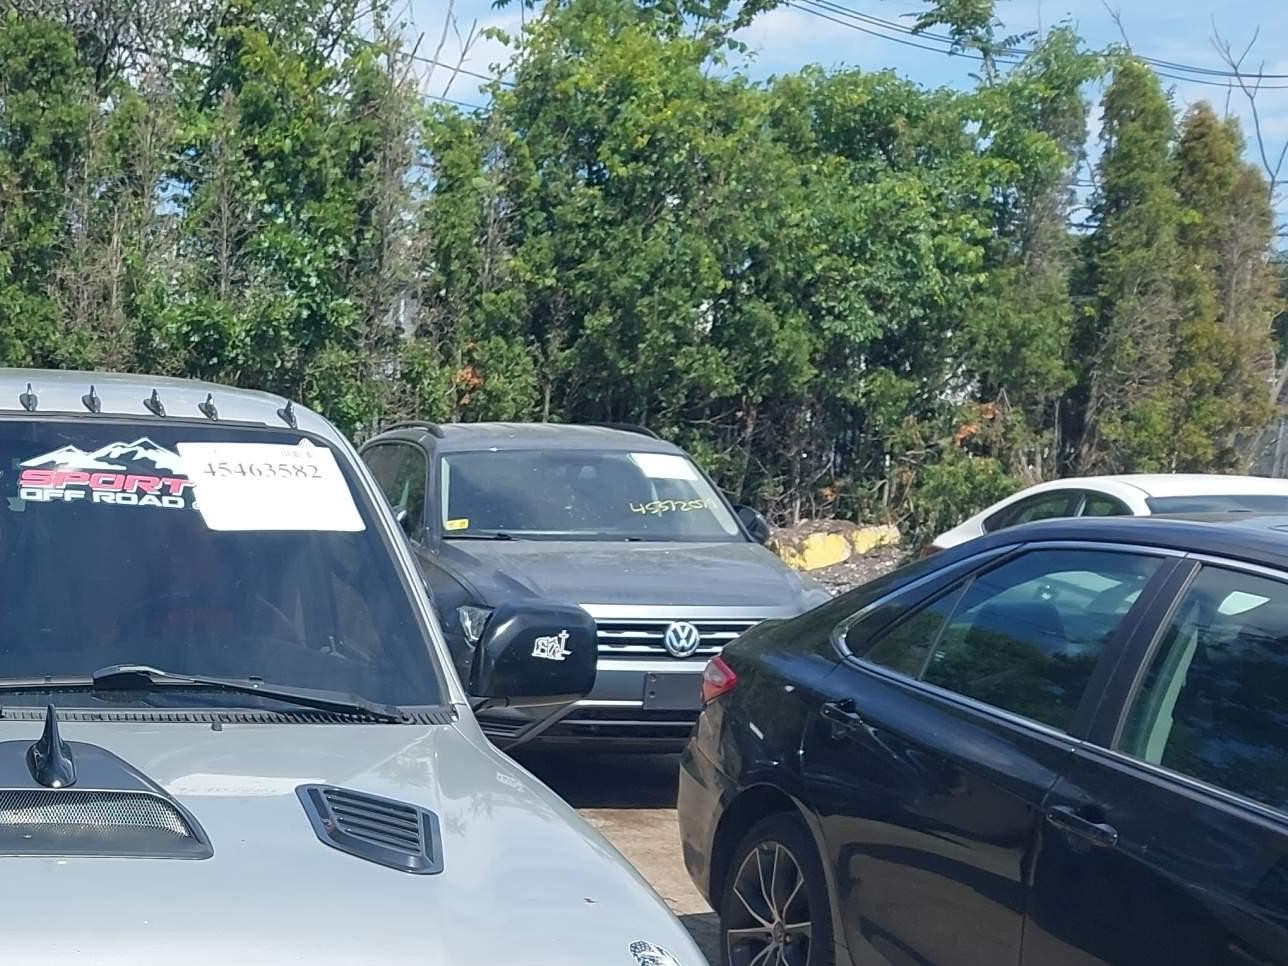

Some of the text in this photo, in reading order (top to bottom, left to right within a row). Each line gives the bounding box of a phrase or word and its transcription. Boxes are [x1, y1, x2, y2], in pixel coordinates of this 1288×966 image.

[203, 462, 323, 479] 45463582
[19, 469, 198, 496] SPORT
[20, 488, 86, 502] OFF
[92, 492, 185, 509] ROAD
